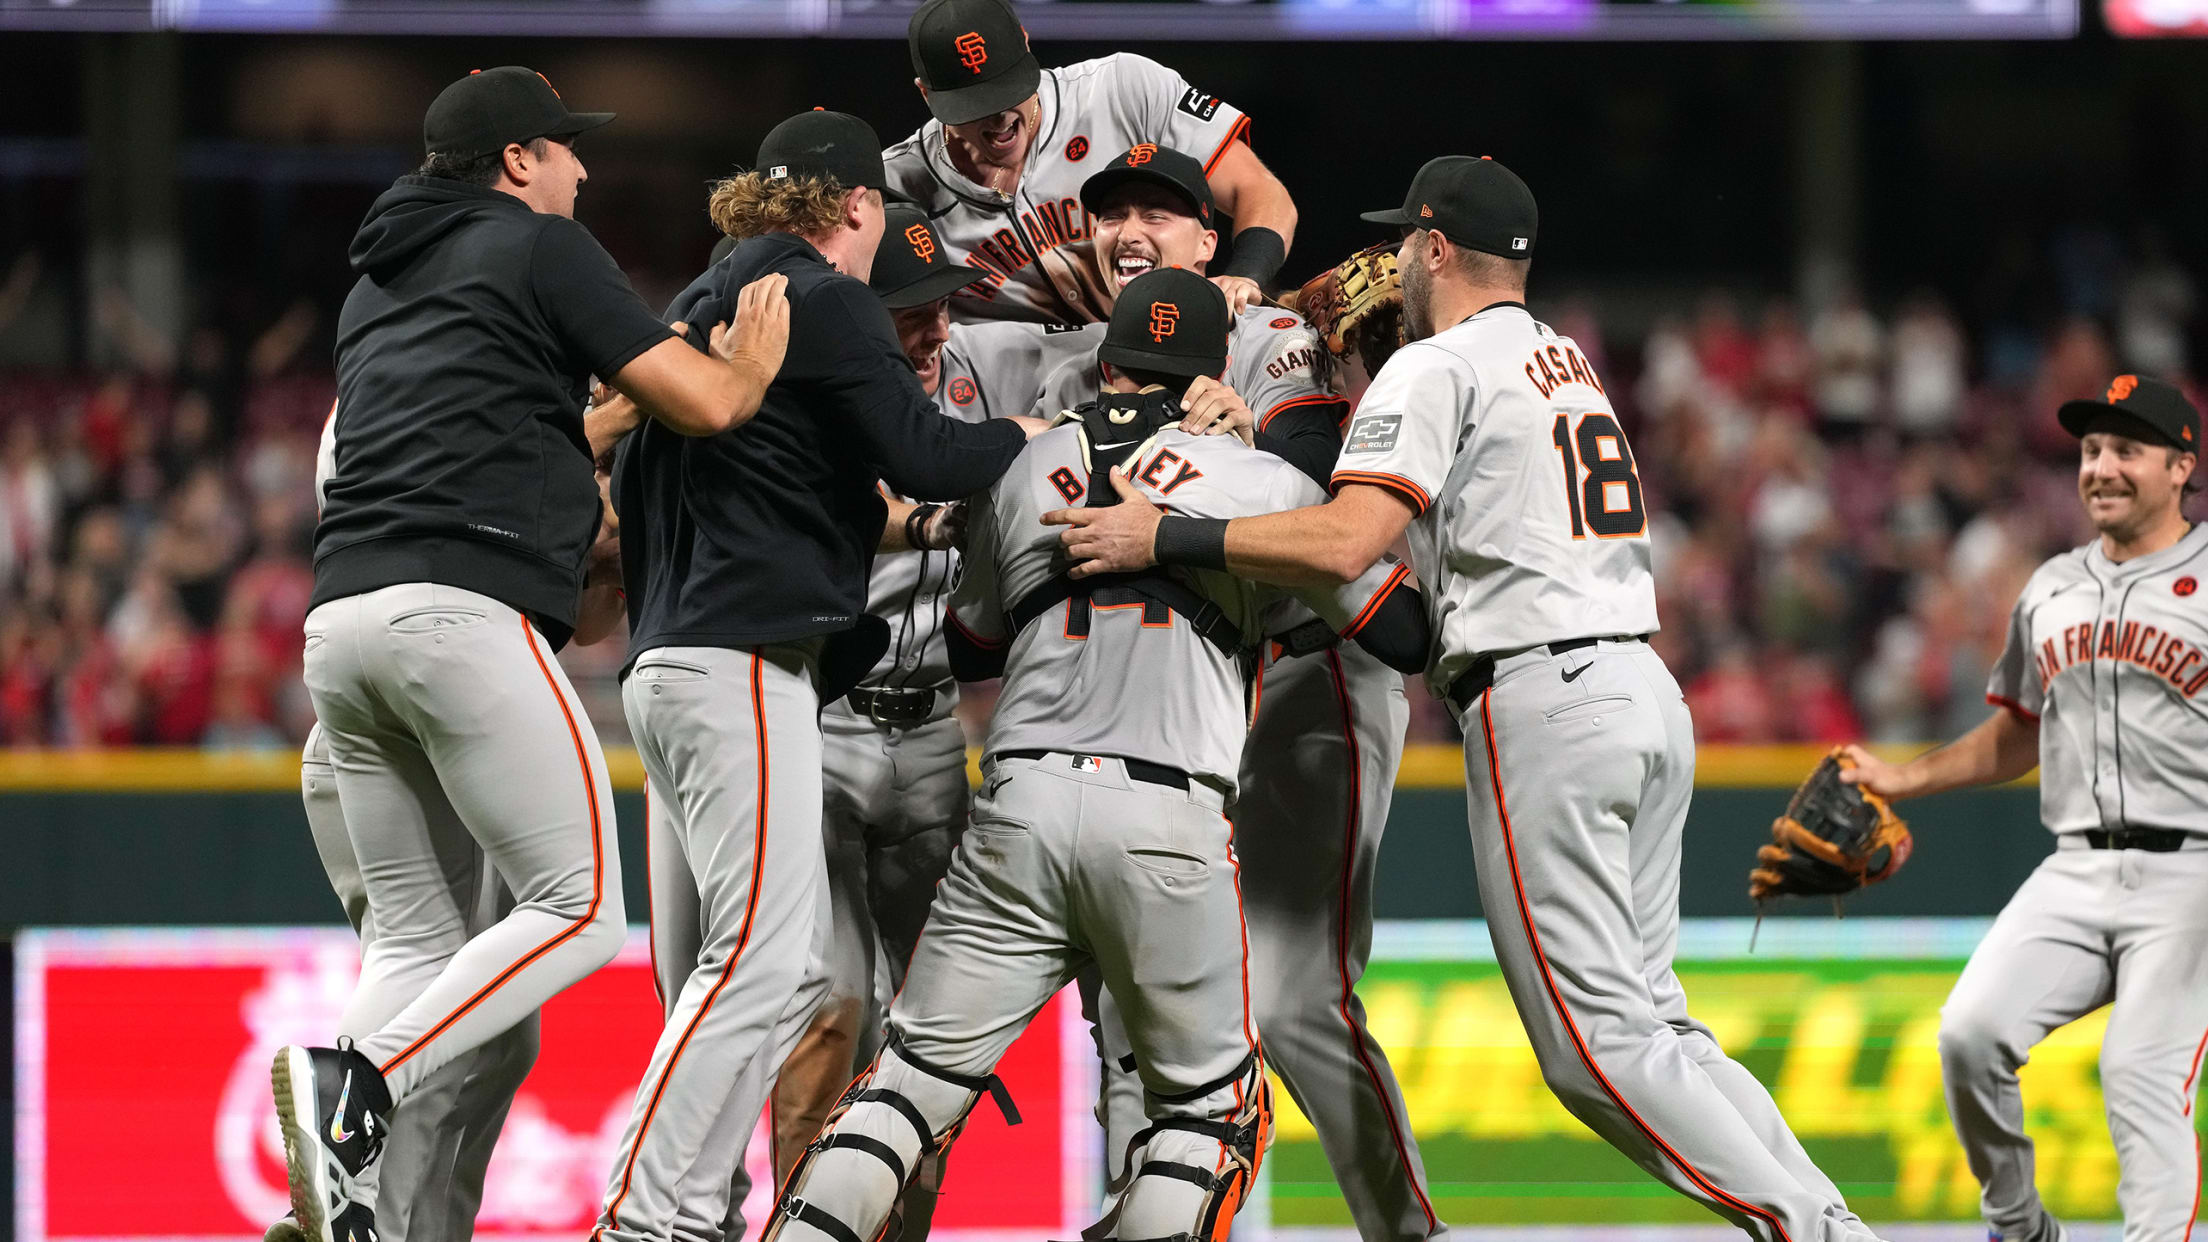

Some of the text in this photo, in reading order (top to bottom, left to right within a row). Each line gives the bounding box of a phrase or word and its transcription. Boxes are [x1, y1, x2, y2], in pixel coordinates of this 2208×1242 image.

[955, 31, 987, 75] SF
[904, 223, 935, 264] SF
[1149, 301, 1179, 343] SF
[1266, 348, 1327, 380] GIANT
[1525, 345, 1606, 400] CASAL
[954, 385, 973, 401] 24
[1350, 441, 1393, 451] CHEVROLET
[1552, 412, 1648, 540] 18
